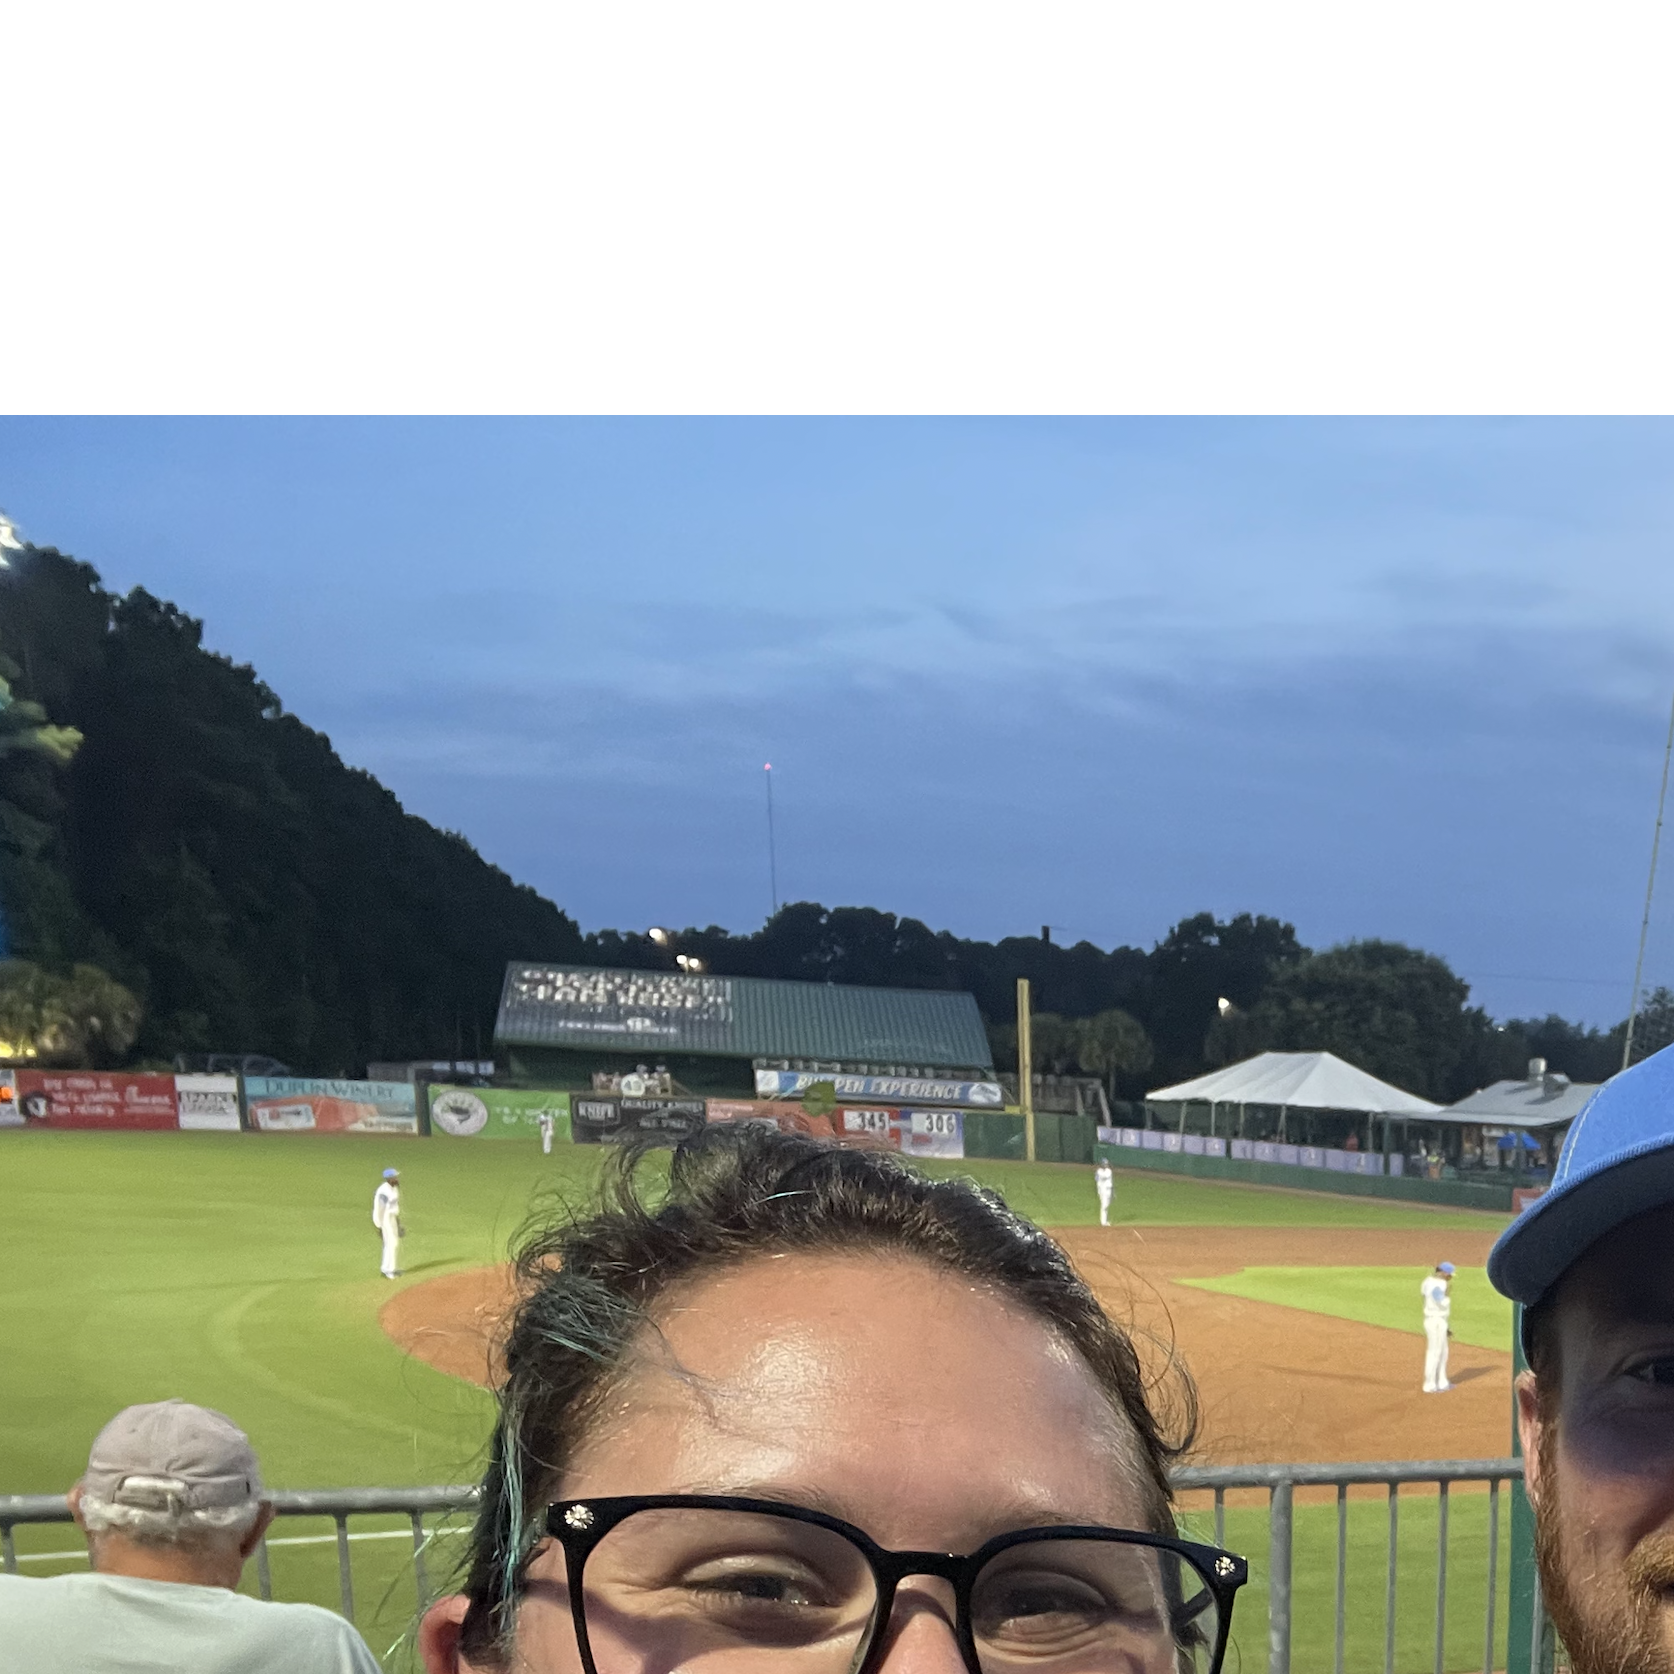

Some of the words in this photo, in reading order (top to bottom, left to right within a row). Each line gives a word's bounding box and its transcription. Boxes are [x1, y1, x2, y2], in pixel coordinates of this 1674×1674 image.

[330, 1081, 393, 1099] WINERY
[797, 1074, 866, 1093] BUPEN
[871, 1079, 962, 1099] EXPERIENCE
[925, 1114, 956, 1134] 306
